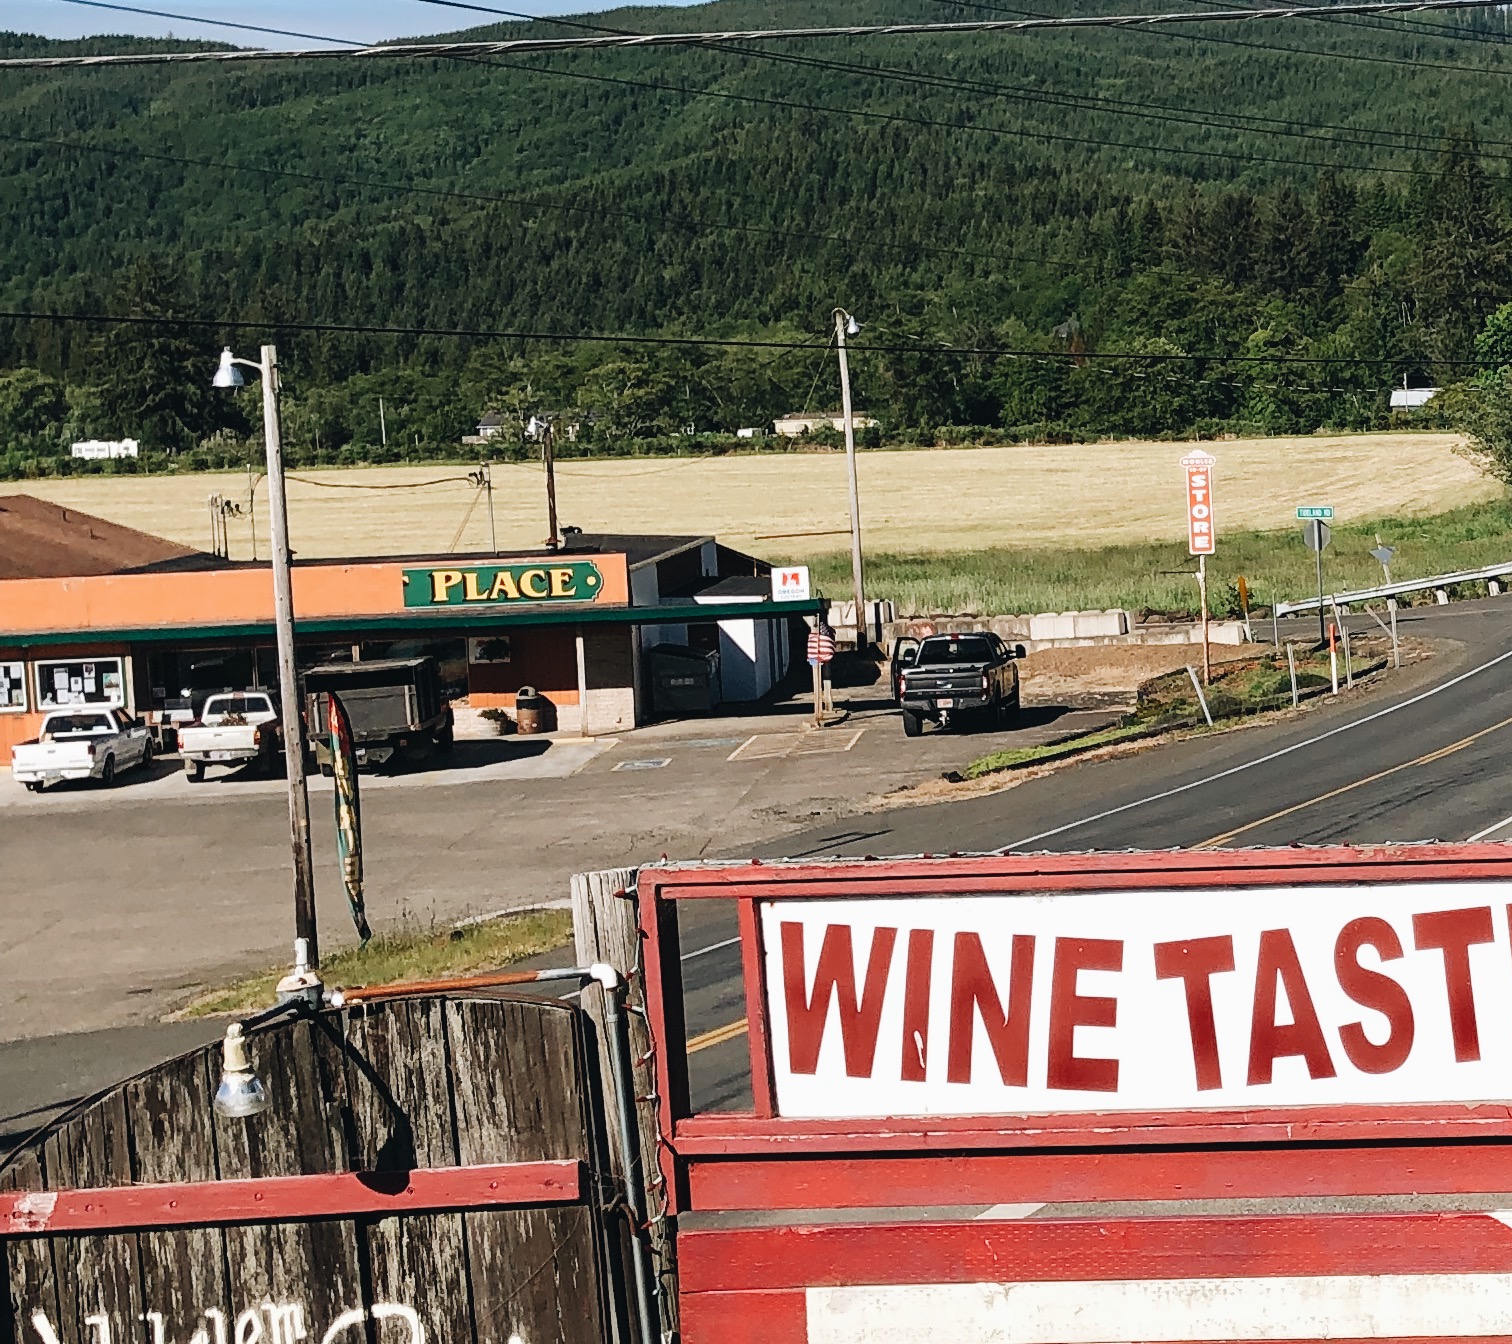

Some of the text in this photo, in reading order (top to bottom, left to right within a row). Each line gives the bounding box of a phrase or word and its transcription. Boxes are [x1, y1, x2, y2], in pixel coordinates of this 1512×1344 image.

[1191, 474, 1210, 549] STORE
[430, 568, 577, 603] PLACE
[780, 920, 1124, 1093] WINE
